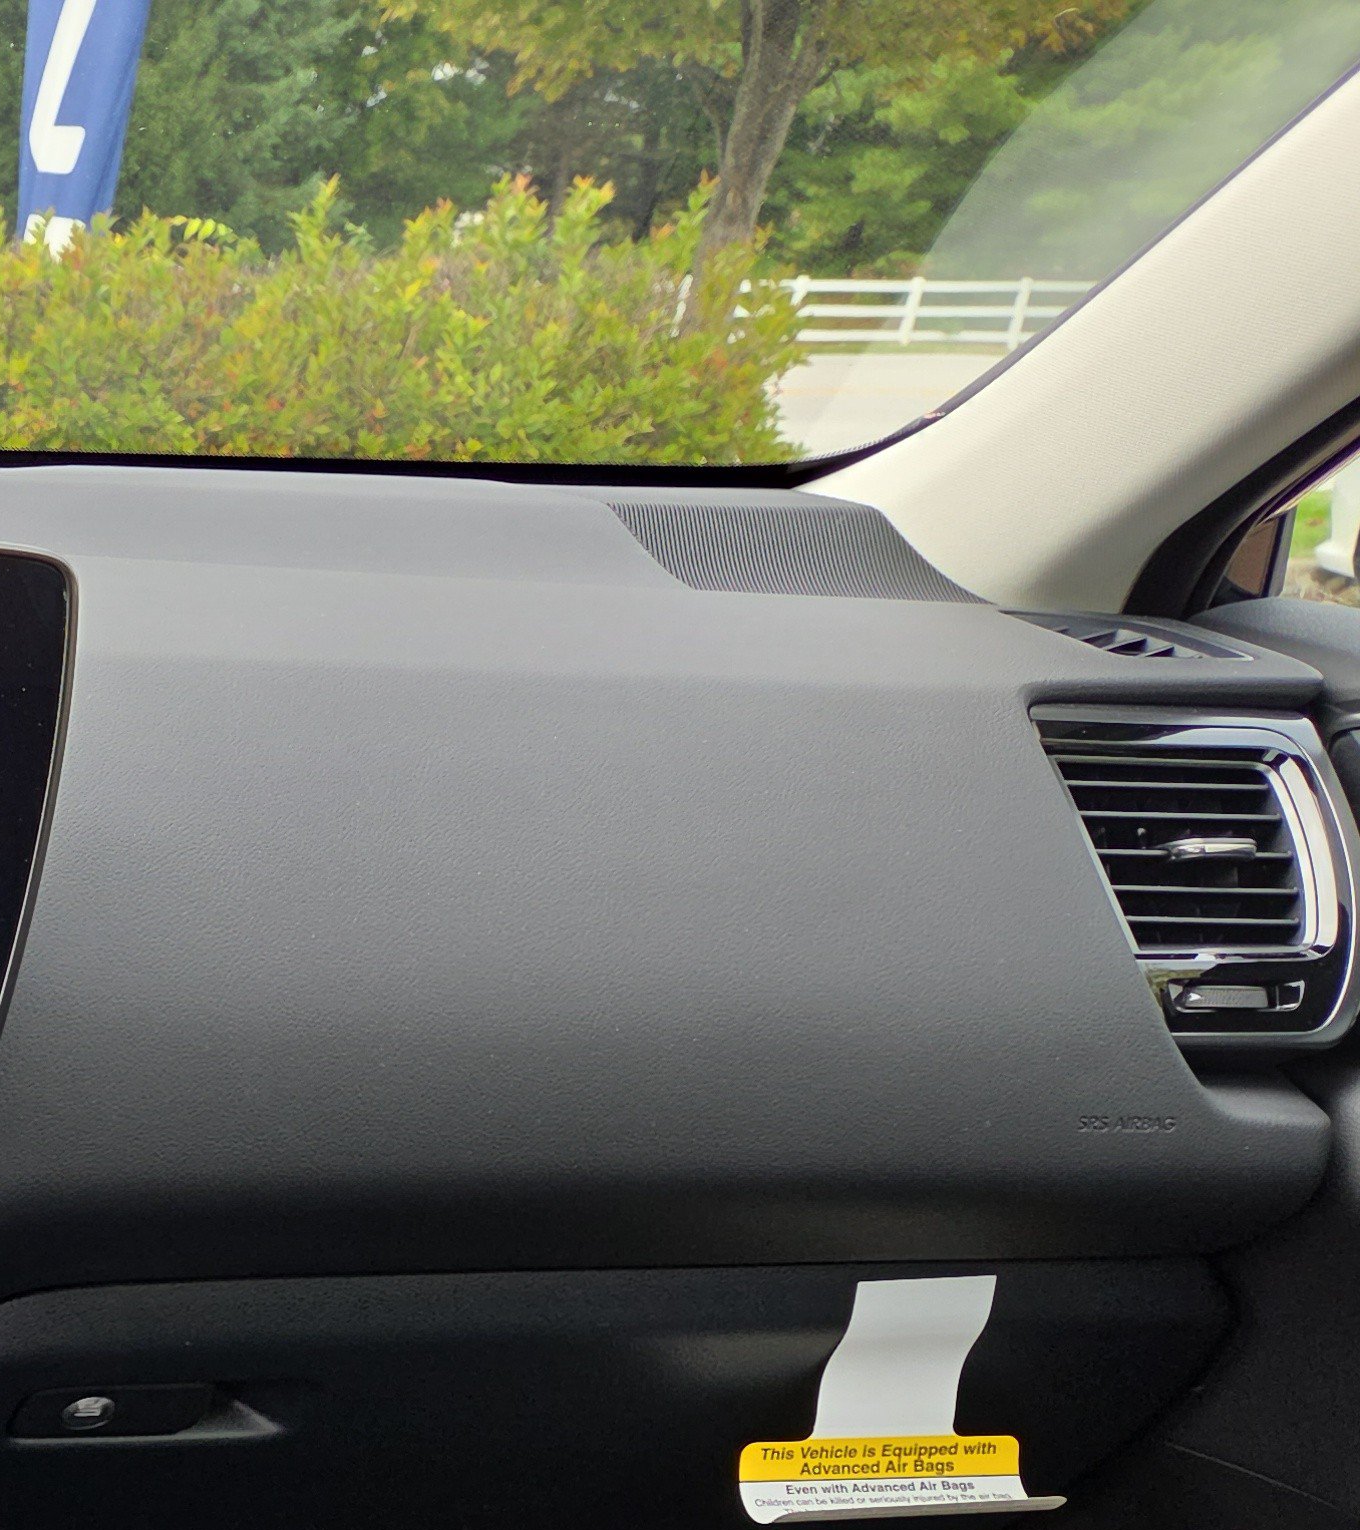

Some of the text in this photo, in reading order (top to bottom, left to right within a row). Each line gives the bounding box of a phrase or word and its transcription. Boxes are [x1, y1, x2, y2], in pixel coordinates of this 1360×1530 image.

[1078, 1115, 1177, 1134] SRS AIRBAG
[761, 1447, 794, 1461] This
[800, 1445, 858, 1460] Vehicle
[881, 1442, 959, 1459] Equipped
[963, 1441, 997, 1455] with
[800, 1459, 955, 1476] Advanced Air Bags
[786, 1480, 976, 1496] Even with Advanced Air Bags
[755, 1497, 794, 1508] Children
[796, 1497, 815, 1506] can
[816, 1496, 828, 1506] be
[830, 1495, 855, 1505] killed
[869, 1494, 910, 1505] seriously
[947, 1492, 959, 1503] by
[960, 1492, 976, 1502] the
